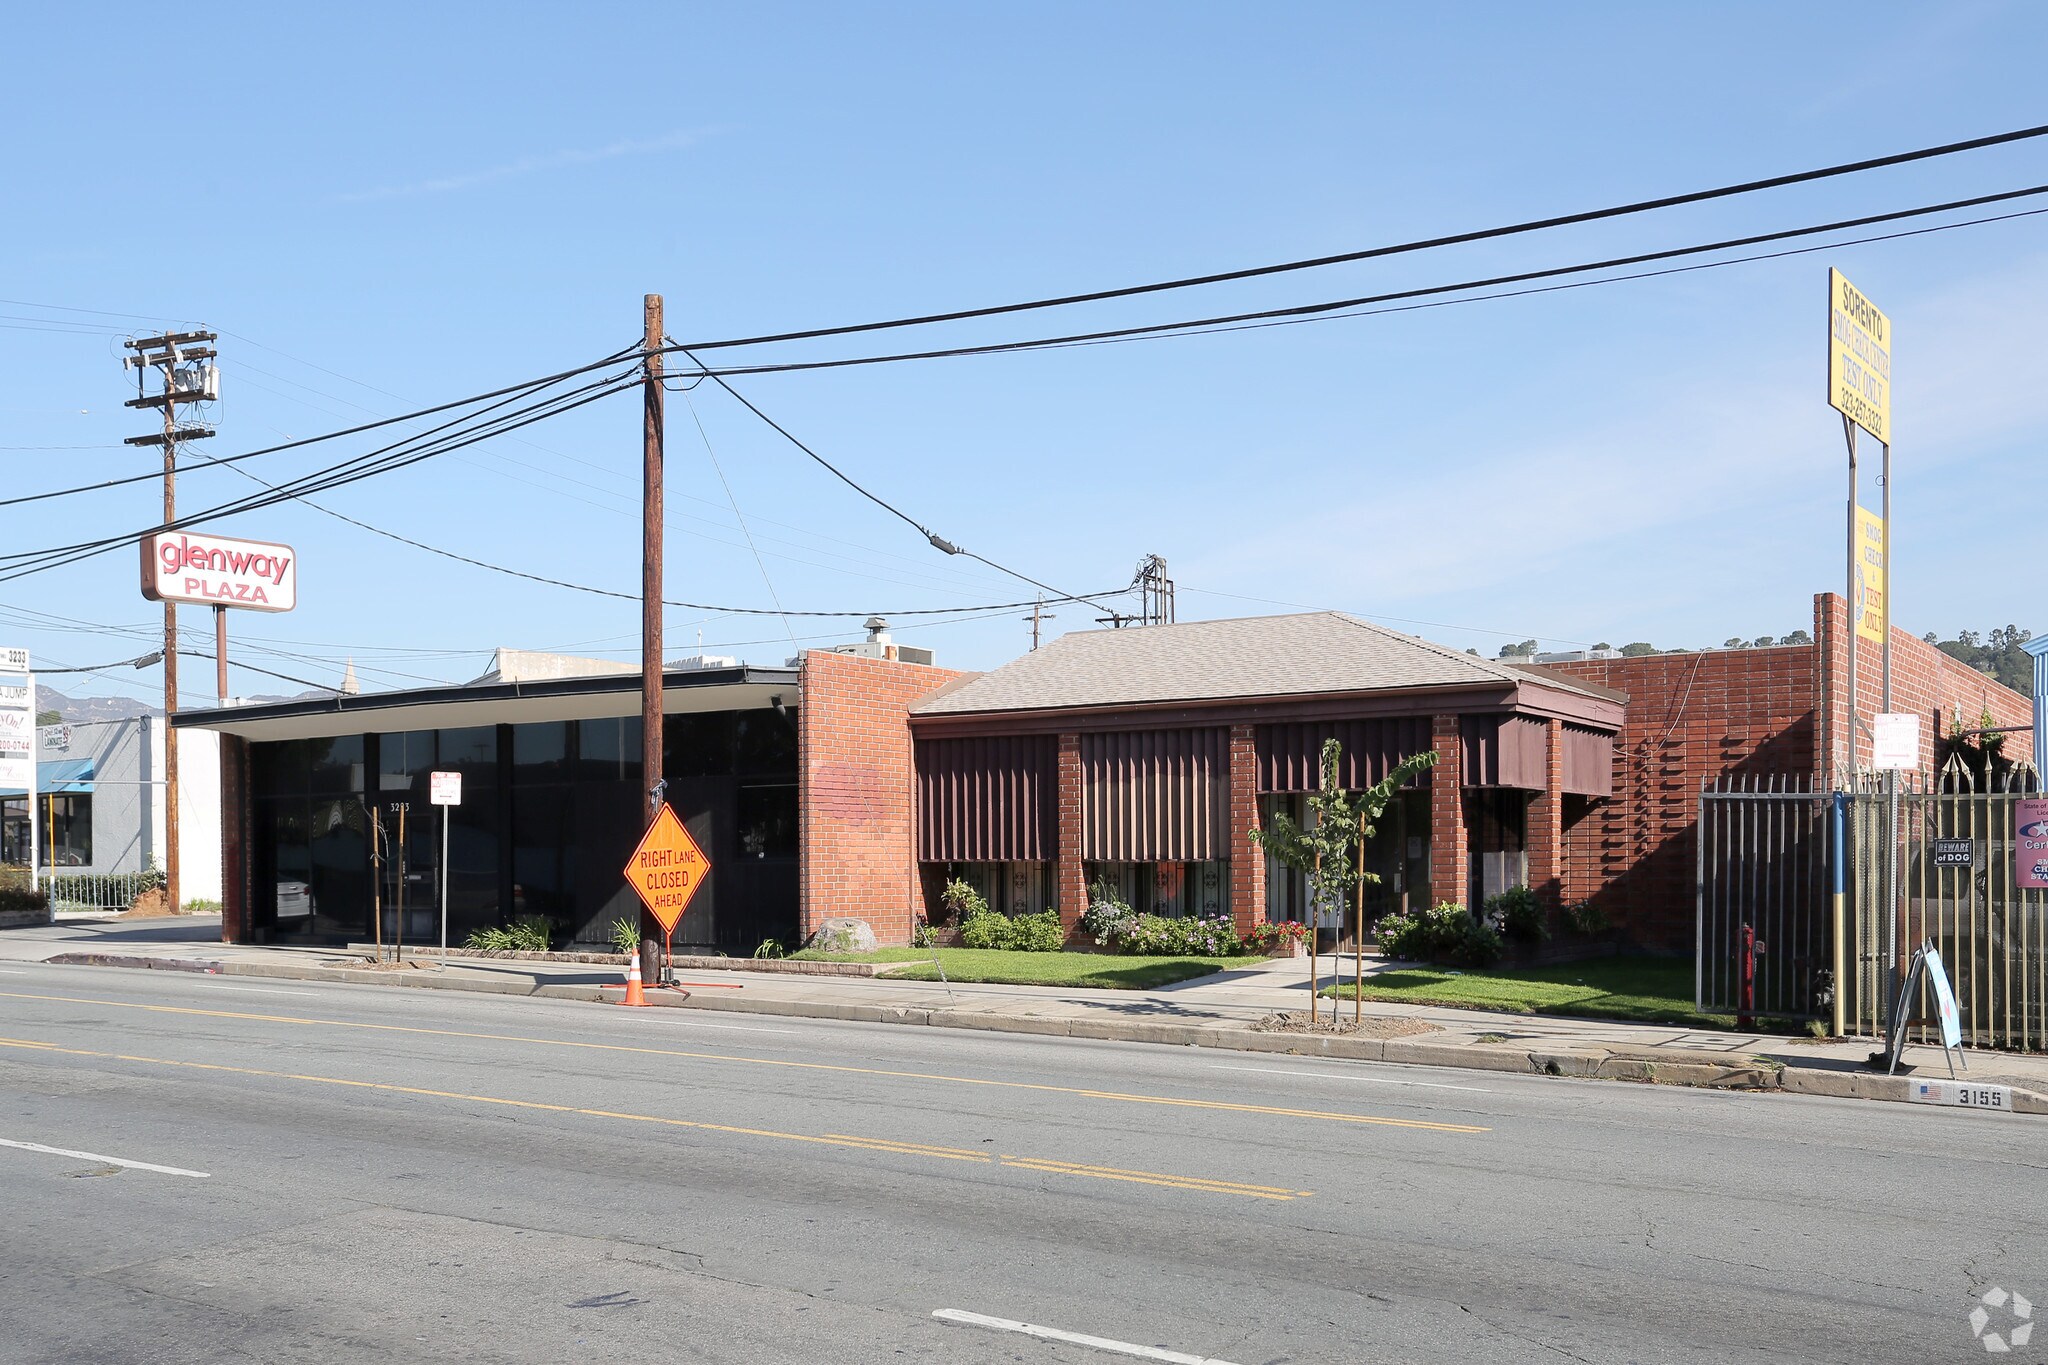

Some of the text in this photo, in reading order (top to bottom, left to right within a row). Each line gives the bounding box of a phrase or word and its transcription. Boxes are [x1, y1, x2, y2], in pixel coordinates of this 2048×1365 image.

[1843, 282, 1882, 342] SORENTO
[1834, 308, 1851, 348] SMOG
[1842, 353, 1883, 409] TEST ONLY
[1841, 387, 1882, 436] 323-257-3322
[1865, 522, 1882, 544] SMOG
[160, 535, 290, 586] glenway
[184, 577, 269, 604] PLAZA
[1865, 586, 1882, 610] TEST
[1864, 609, 1883, 634] ONLY
[8, 649, 26, 664] 3233
[5, 688, 28, 699] JUMP
[390, 802, 410, 812] 323
[1937, 853, 1970, 862] of DOG
[1938, 842, 1970, 853] BEWARE
[641, 850, 696, 868] RIGHT LANE
[647, 871, 689, 890] CLOSED
[654, 893, 683, 908] AHEAD
[1960, 1089, 2001, 1106] 3155
